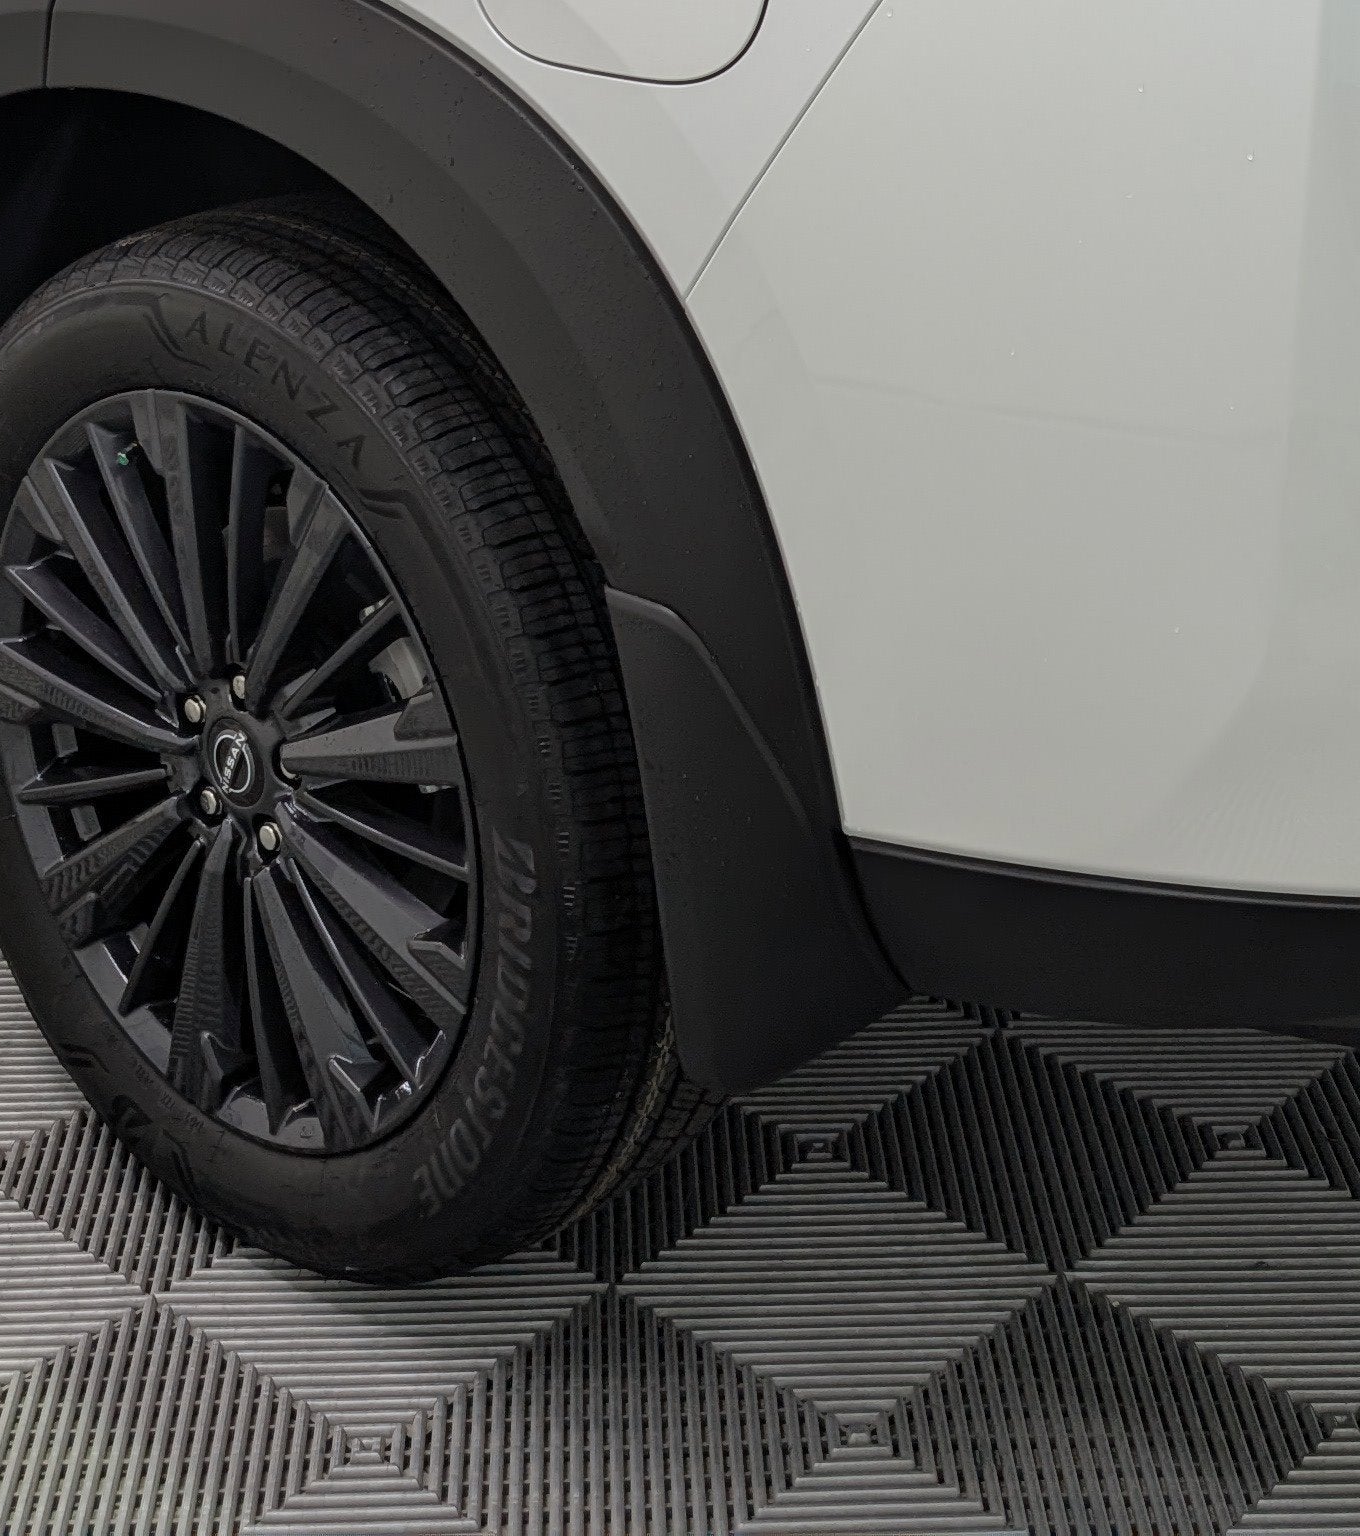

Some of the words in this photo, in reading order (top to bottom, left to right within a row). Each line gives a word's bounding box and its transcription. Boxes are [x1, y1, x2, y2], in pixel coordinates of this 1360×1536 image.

[183, 310, 368, 472] ALENZA
[221, 732, 246, 793] NISSAN
[410, 836, 536, 1220] BRIDGESTONE
